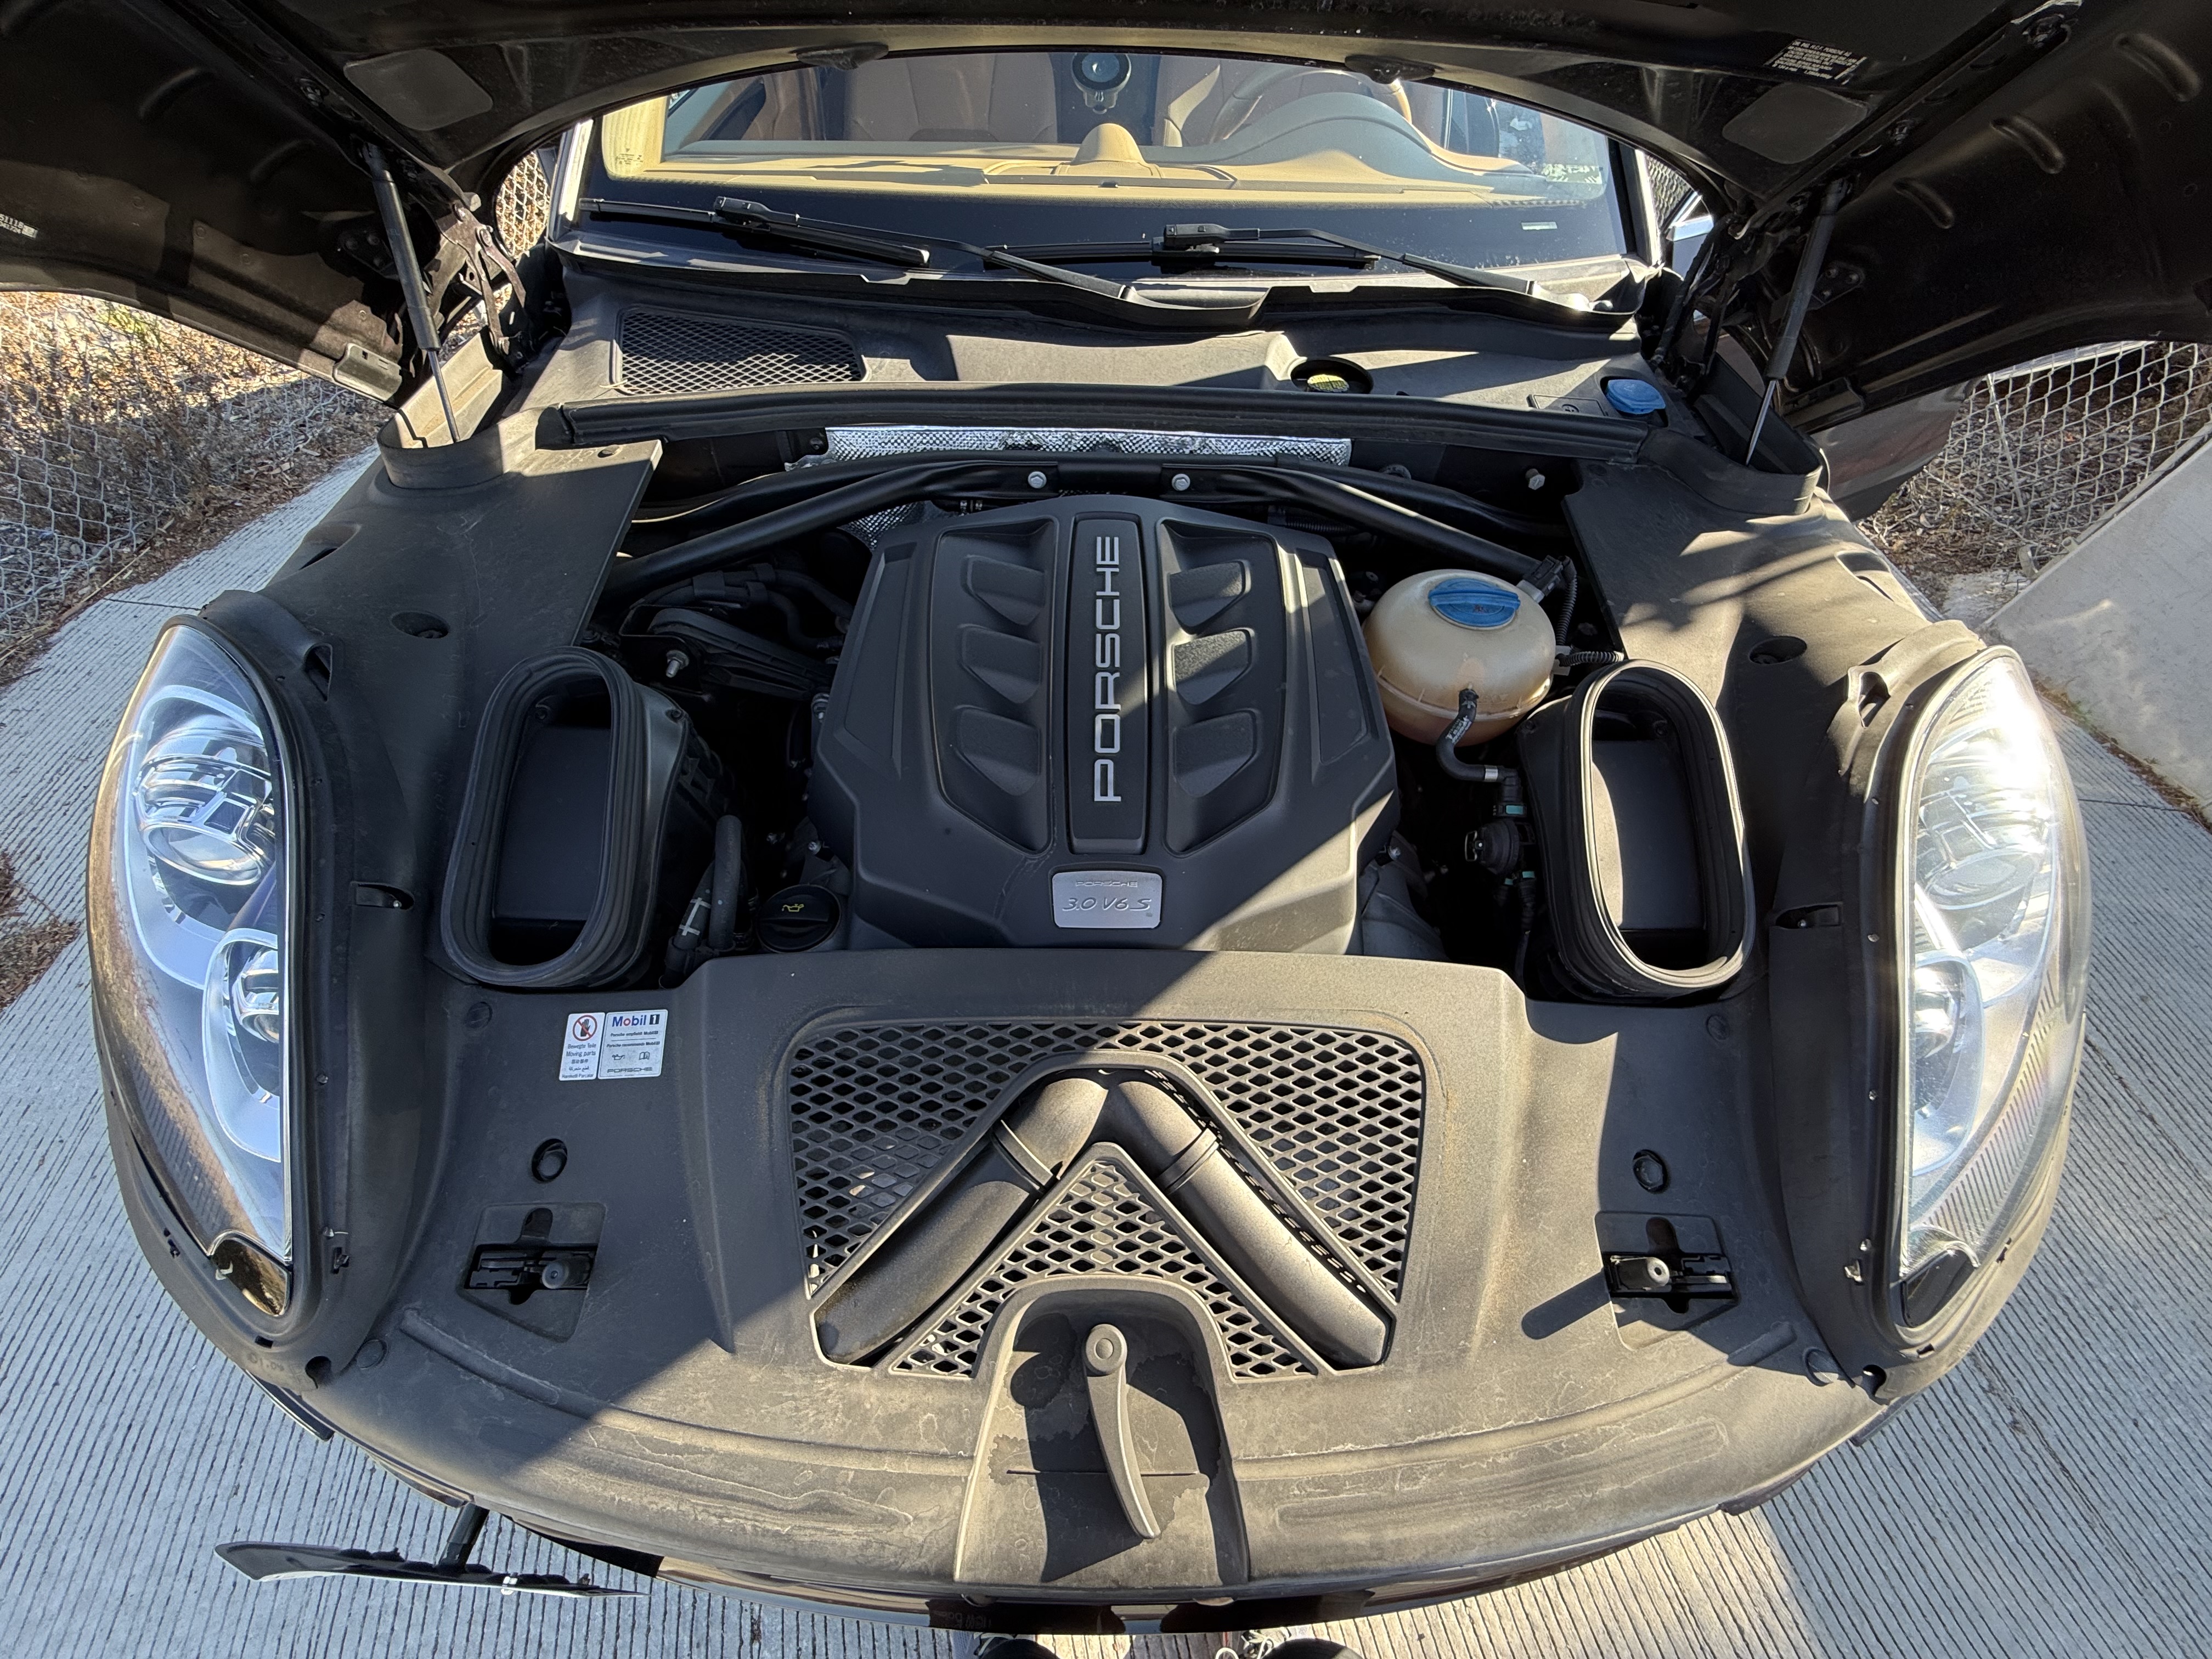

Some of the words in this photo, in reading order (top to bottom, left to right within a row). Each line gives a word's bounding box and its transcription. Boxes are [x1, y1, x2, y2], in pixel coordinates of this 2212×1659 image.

[1094, 537, 1121, 802] PORSCHE
[1062, 896, 1097, 911] 3.0
[1102, 896, 1129, 911] V6
[1129, 898, 1152, 911] S
[612, 1015, 647, 1027] Mobil
